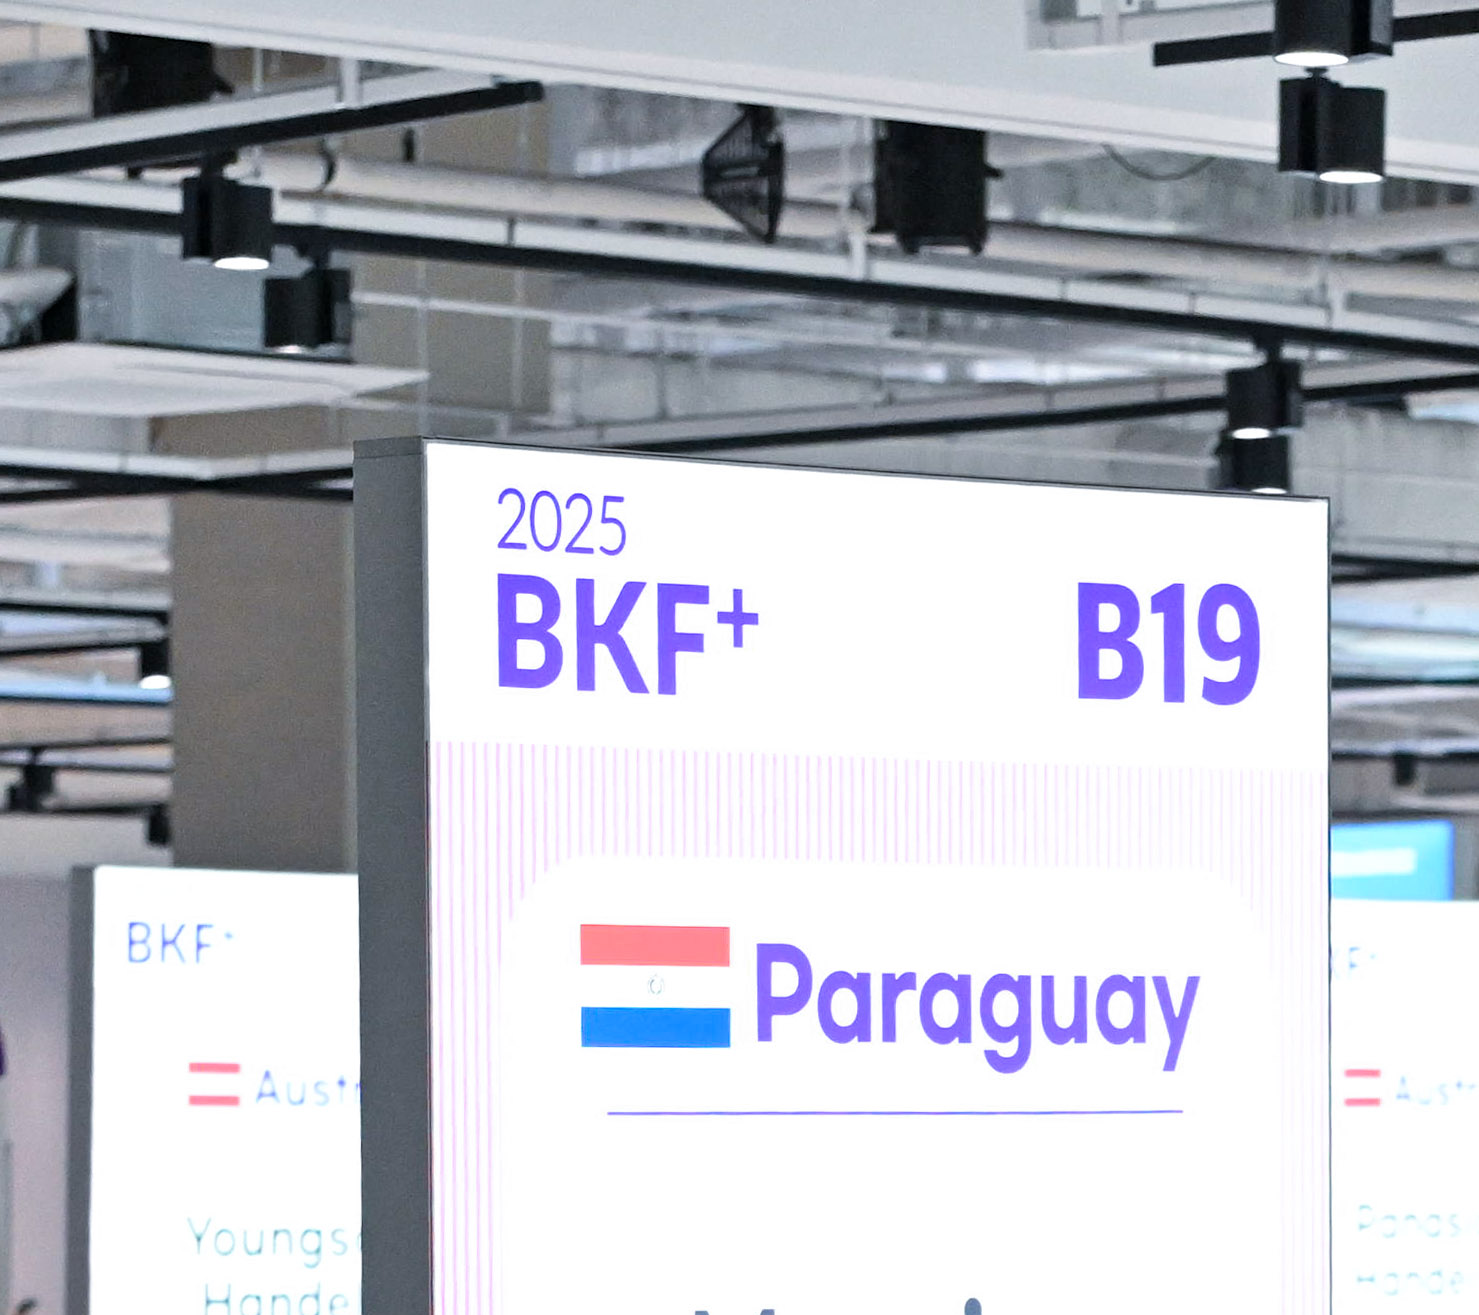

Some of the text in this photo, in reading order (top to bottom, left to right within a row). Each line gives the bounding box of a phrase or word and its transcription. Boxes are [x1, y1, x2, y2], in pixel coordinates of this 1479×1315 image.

[496, 487, 627, 555] 2025
[496, 572, 1261, 706] BKF+ B19
[755, 942, 1201, 1073] Paraguay
